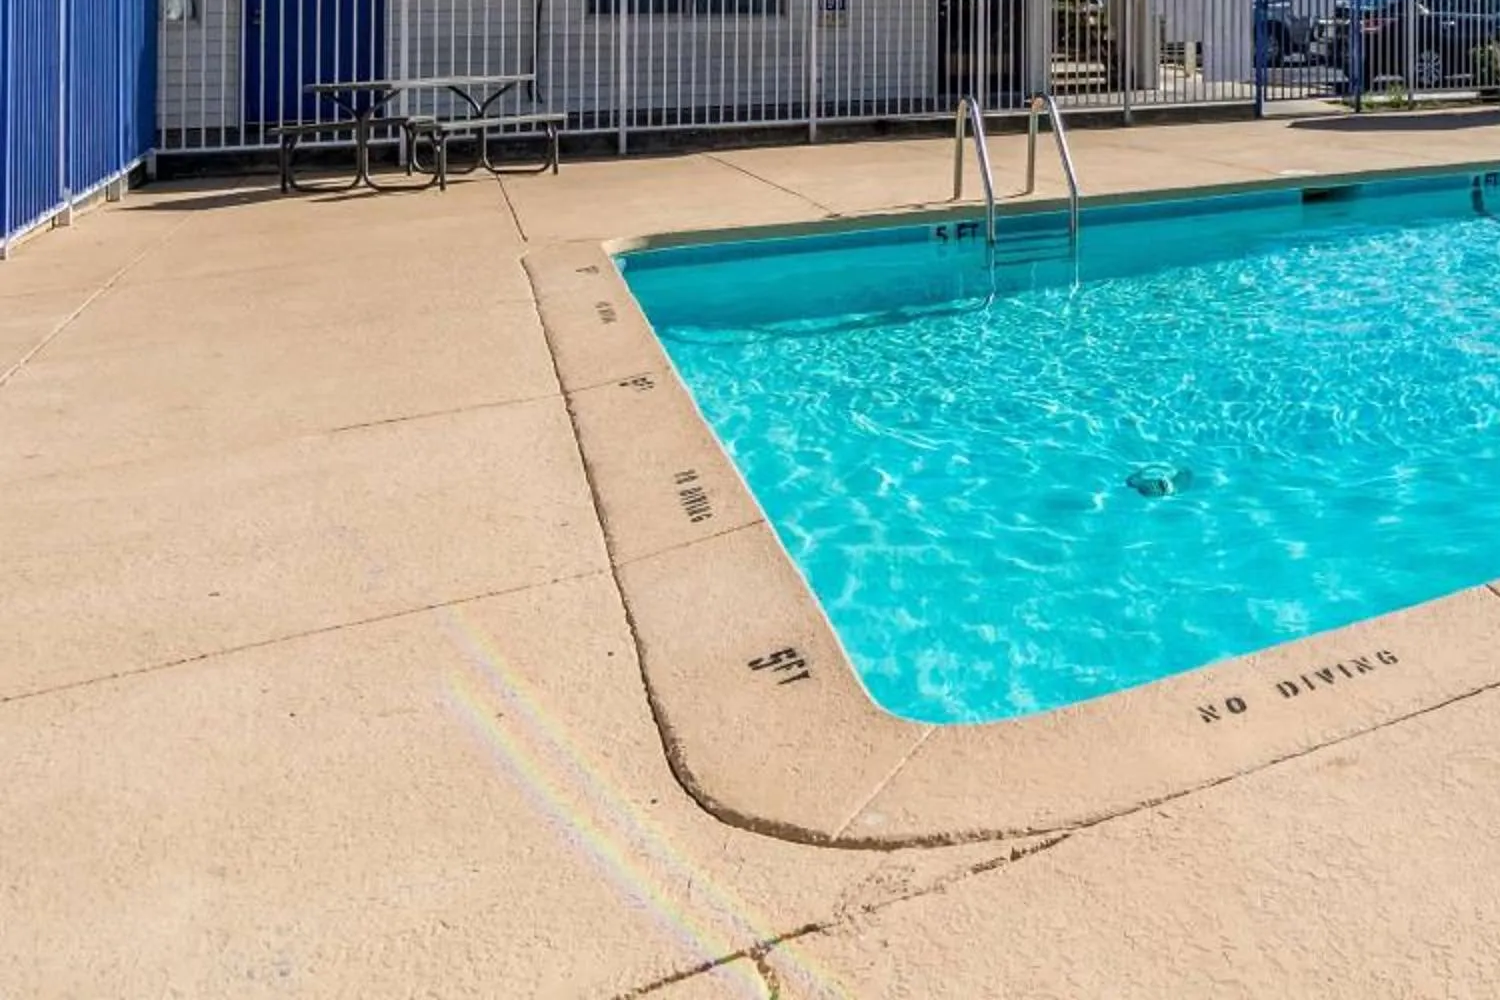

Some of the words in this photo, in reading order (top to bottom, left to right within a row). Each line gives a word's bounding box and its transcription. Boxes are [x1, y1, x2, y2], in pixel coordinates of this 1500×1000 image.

[957, 222, 979, 243] FT
[748, 647, 811, 686] 5FT
[1197, 696, 1248, 724] NO
[1275, 649, 1400, 699] DIVING
